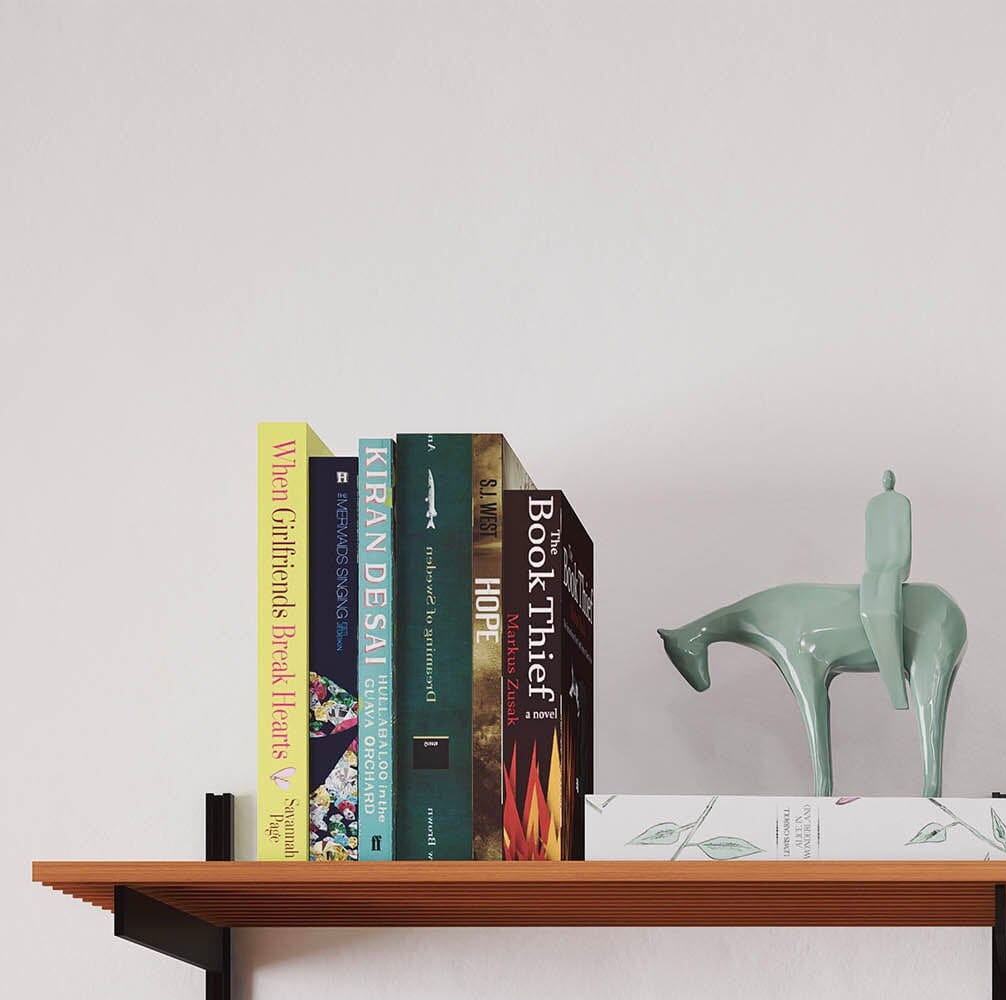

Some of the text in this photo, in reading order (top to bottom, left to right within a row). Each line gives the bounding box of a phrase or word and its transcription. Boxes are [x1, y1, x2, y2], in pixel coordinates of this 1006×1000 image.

[337, 499, 348, 564] MERMAIDS
[480, 479, 498, 538] S.J. WEST
[365, 447, 388, 665] KIRAN DESAI
[550, 529, 561, 556] The
[271, 439, 297, 760] When Girlfriends Break Hearts
[337, 567, 348, 619] SINGING
[475, 577, 501, 644] HOPE
[529, 496, 554, 702] Book Thief
[506, 613, 519, 726] Markus Zusak
[526, 711, 532, 719] a
[533, 708, 559, 720] novel
[364, 679, 375, 815] GUAVA ORCHARD
[377, 674, 389, 823] HULLABALOO in the
[265, 813, 283, 844] Page
[285, 797, 299, 858] Savannah
